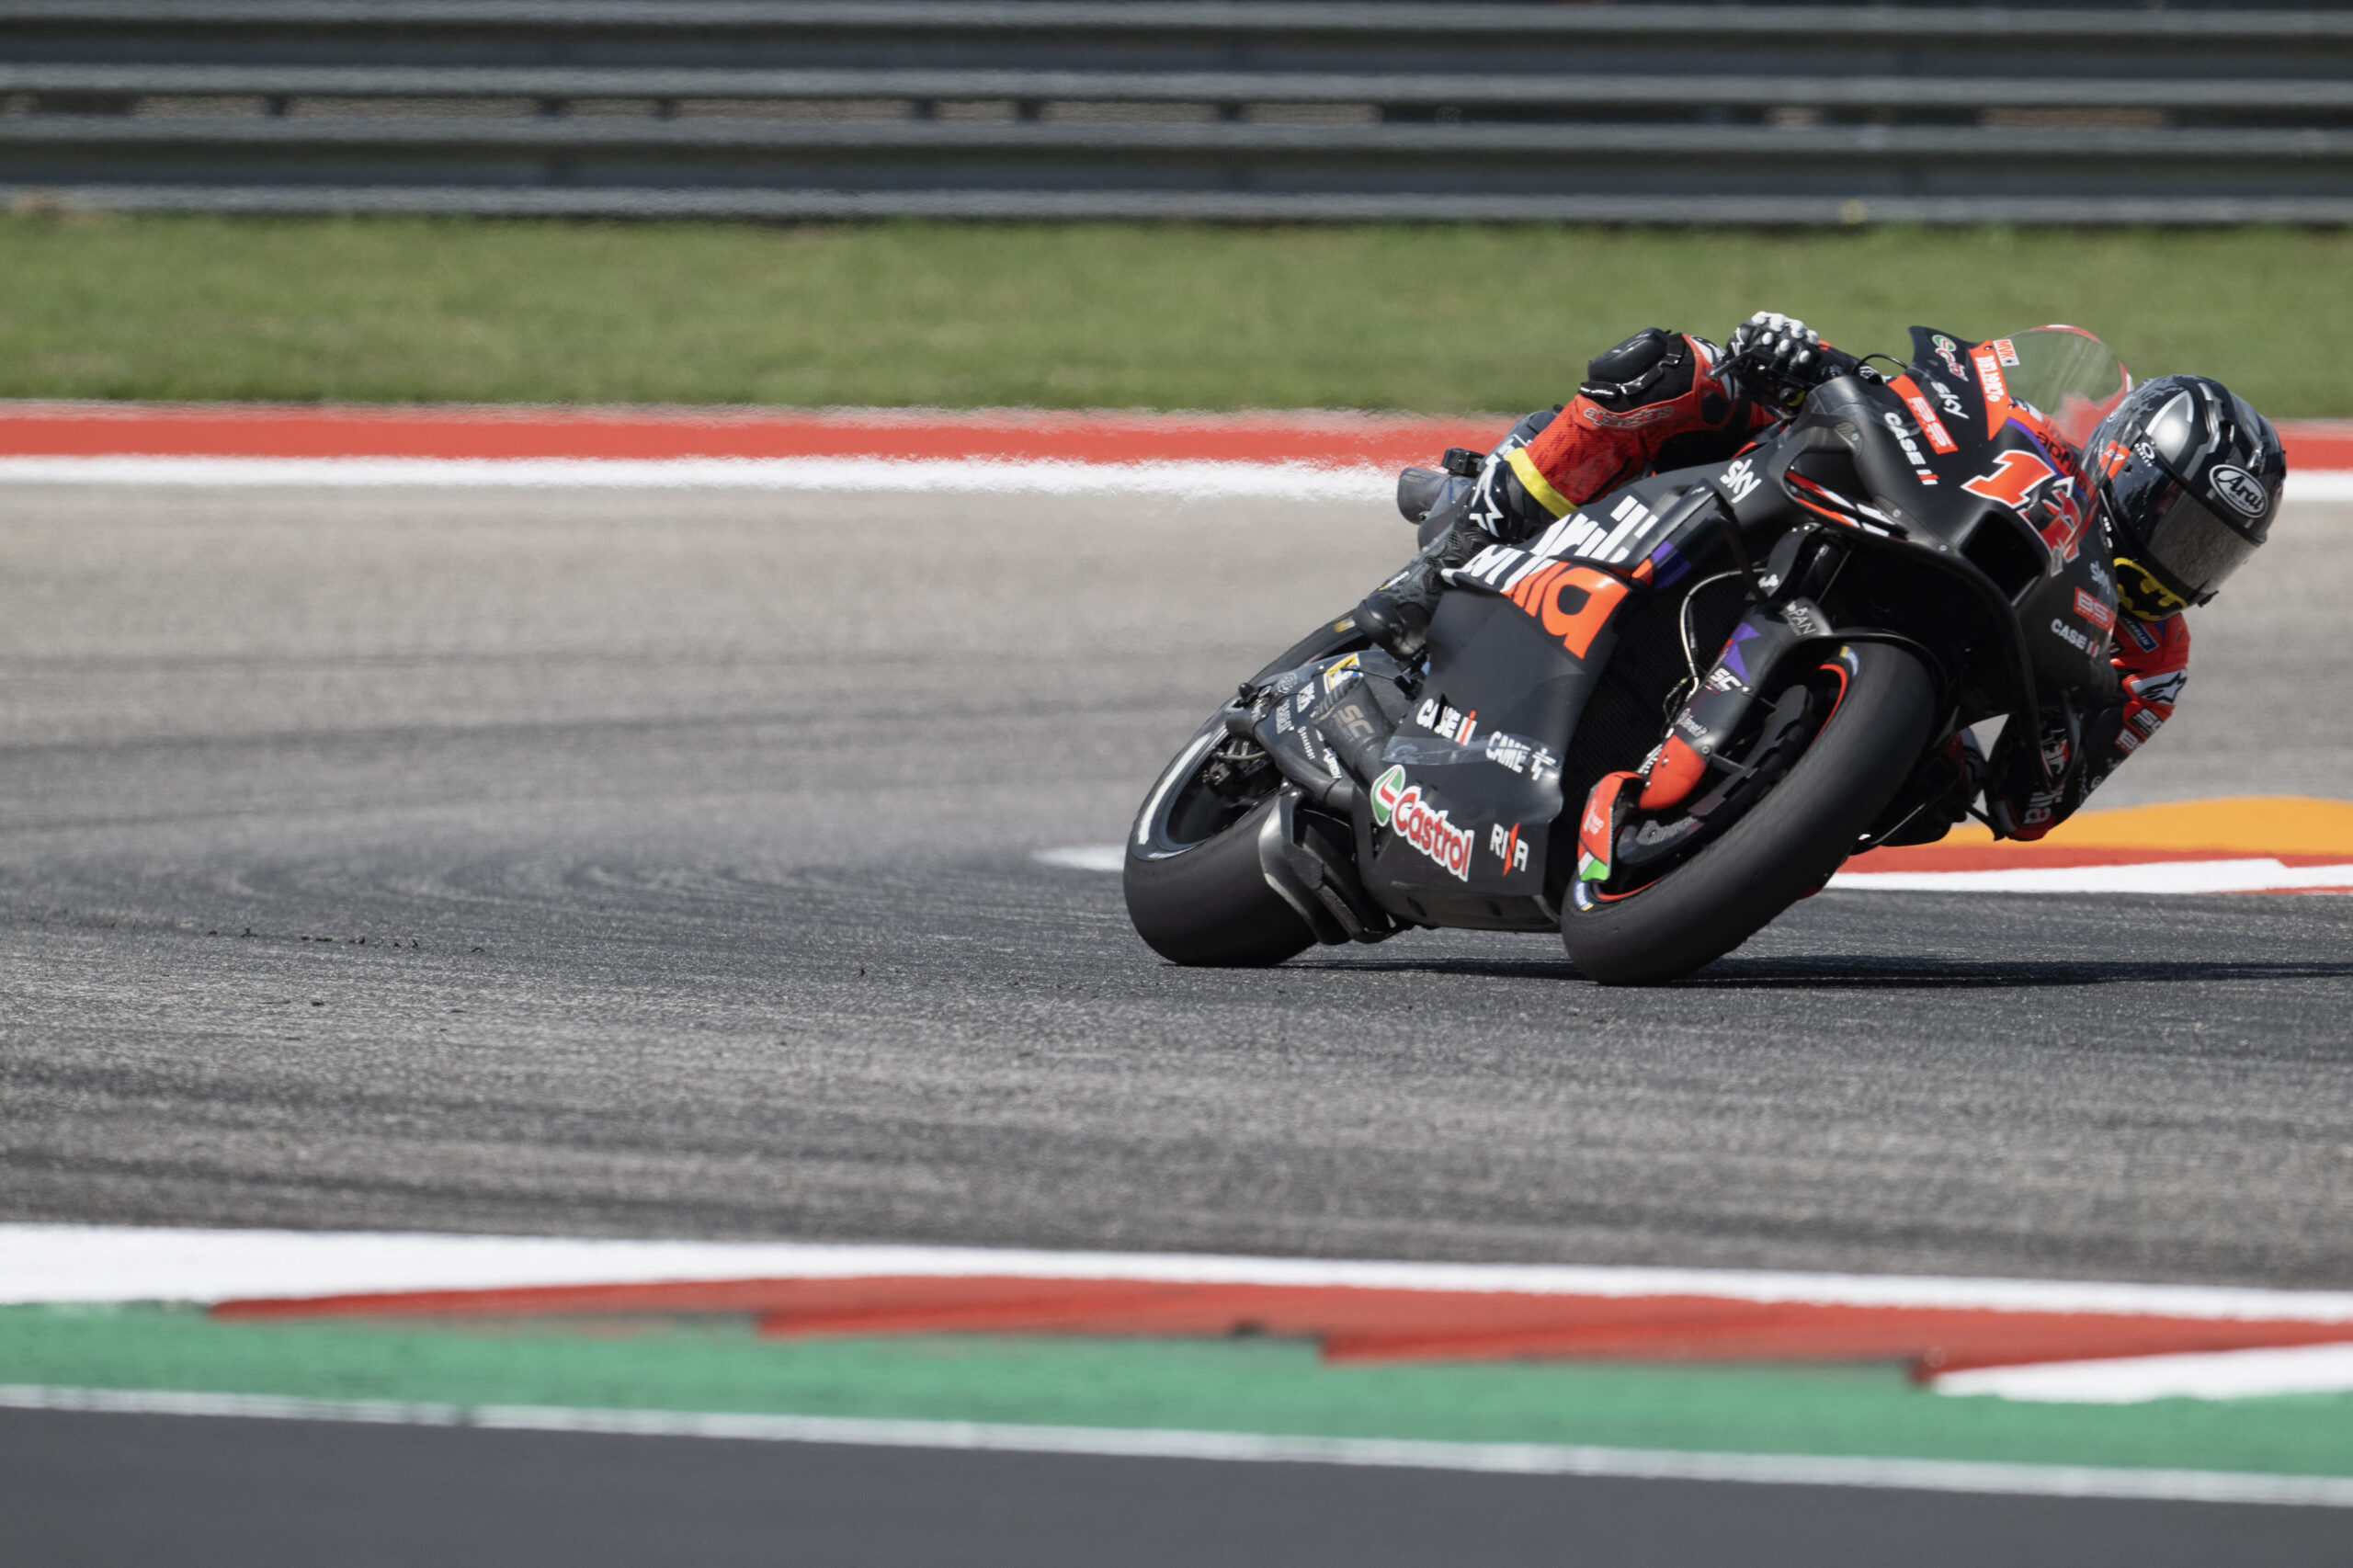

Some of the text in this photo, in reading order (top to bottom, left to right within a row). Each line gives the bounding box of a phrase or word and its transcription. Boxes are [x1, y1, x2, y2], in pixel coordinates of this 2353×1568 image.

[1930, 381, 1970, 419] sky
[1884, 412, 1927, 465] CASE
[2034, 430, 2089, 492] aprilia
[1719, 458, 1762, 504] sky
[2214, 474, 2262, 510] Arai
[2077, 590, 2109, 622] BS
[2051, 618, 2087, 650] CASE
[1710, 667, 1743, 692] SC
[1344, 704, 1376, 739] SC
[1485, 731, 1531, 773] CAME
[1392, 787, 1473, 881] Castrol
